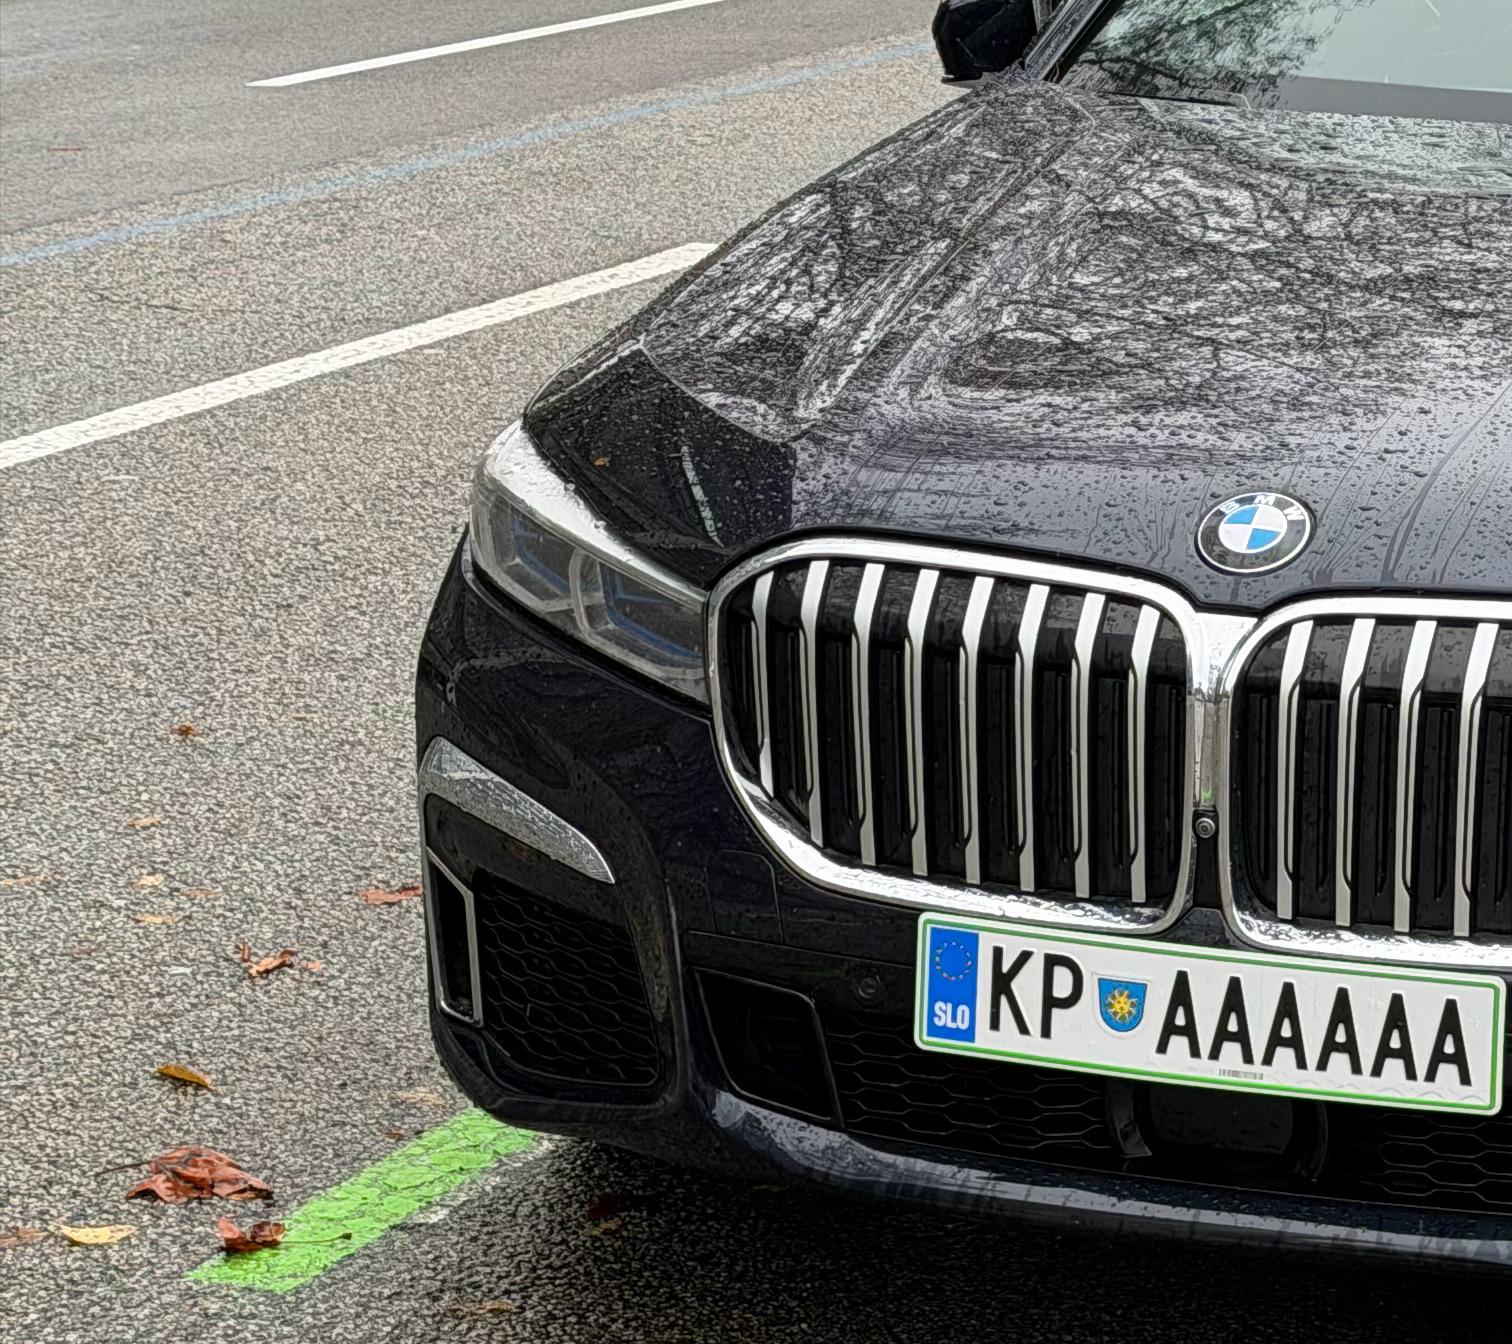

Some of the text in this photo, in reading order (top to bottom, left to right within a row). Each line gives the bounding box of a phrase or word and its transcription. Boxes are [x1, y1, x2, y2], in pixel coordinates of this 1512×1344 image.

[1219, 494, 1305, 521] BMW
[933, 1001, 970, 1030] SLO
[989, 944, 1473, 1087] KP AAAAAA
